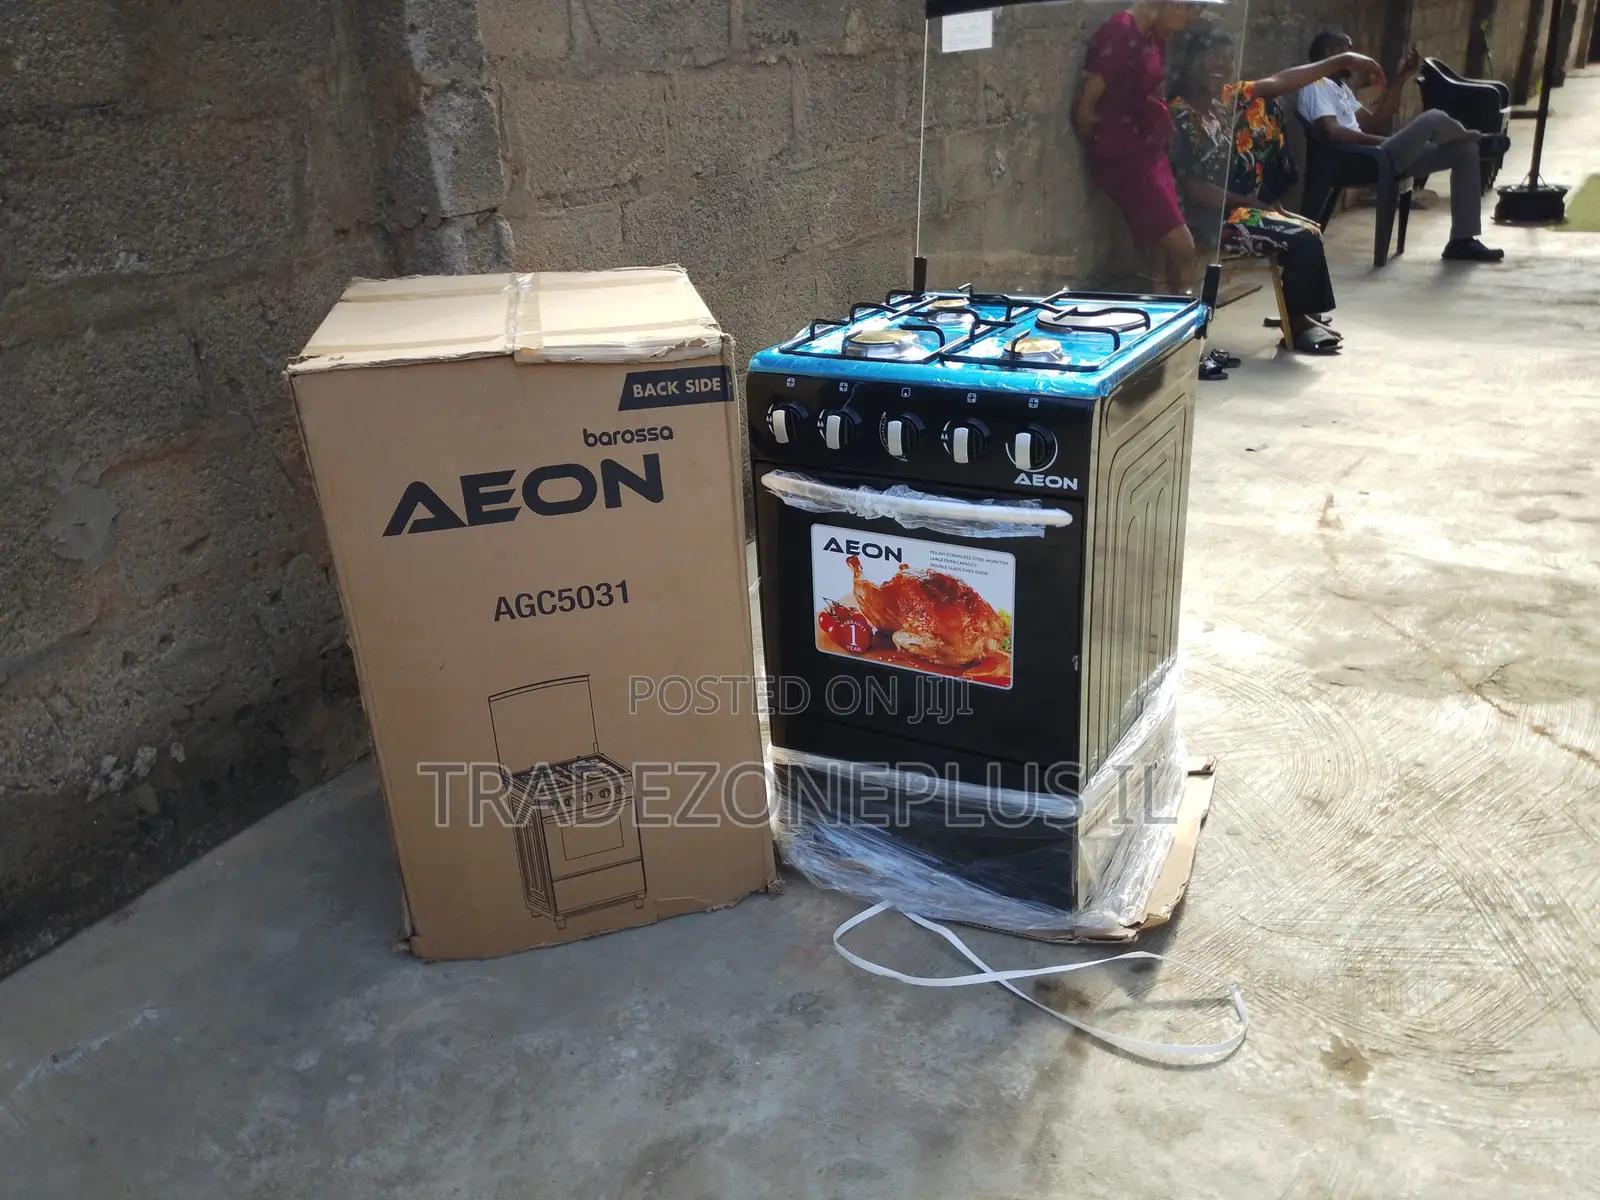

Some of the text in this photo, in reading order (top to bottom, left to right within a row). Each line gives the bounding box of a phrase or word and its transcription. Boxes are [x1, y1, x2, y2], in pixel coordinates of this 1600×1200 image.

[632, 377, 722, 398] BACK SIDE
[583, 424, 674, 448] barossa
[1014, 472, 1078, 491] AEON
[381, 453, 665, 538] AEON
[822, 536, 903, 563] AEON
[493, 580, 629, 622] AGC5031
[849, 624, 858, 646] 1
[846, 644, 862, 653] YEAR
